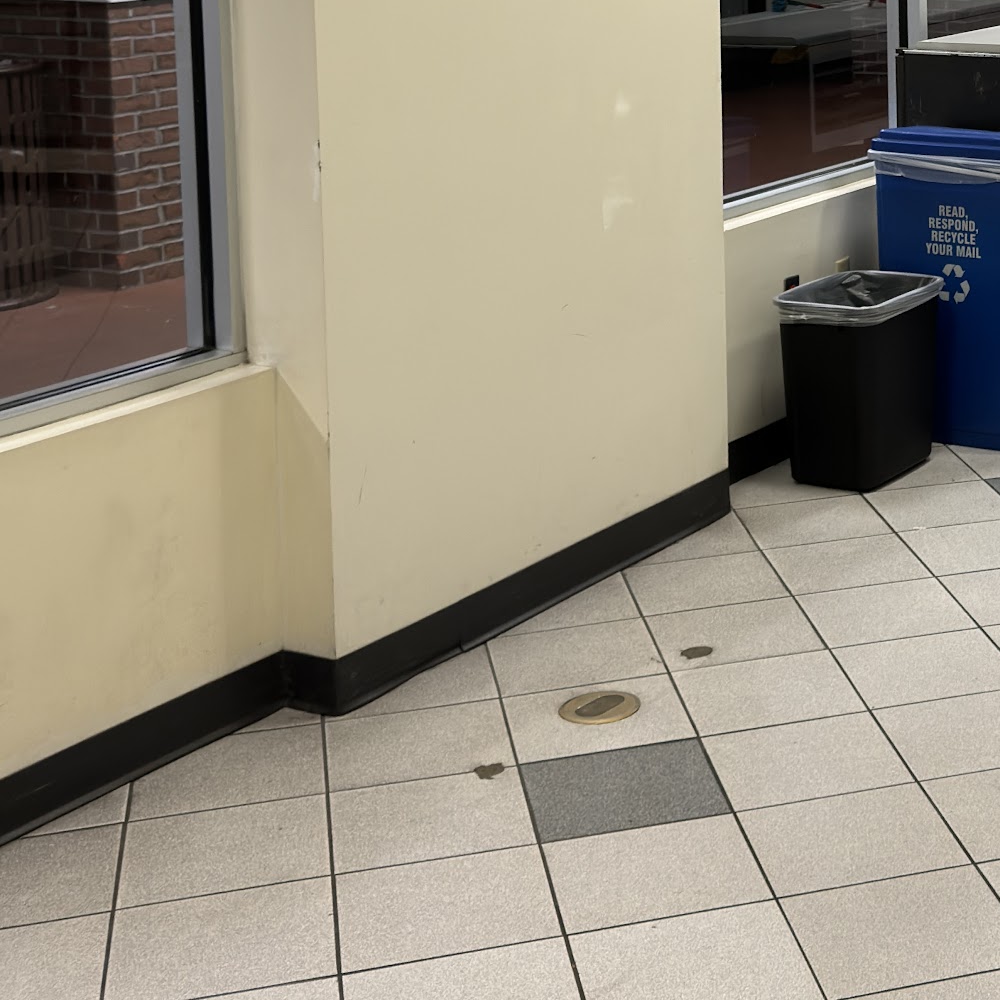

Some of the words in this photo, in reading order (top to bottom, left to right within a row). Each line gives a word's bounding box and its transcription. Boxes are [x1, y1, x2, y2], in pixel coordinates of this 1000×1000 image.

[939, 205, 968, 220] READ,
[929, 218, 979, 234] RESPOND,
[932, 230, 976, 246] RECYCLE
[926, 242, 953, 256] YOUR
[956, 245, 982, 259] MAIL
